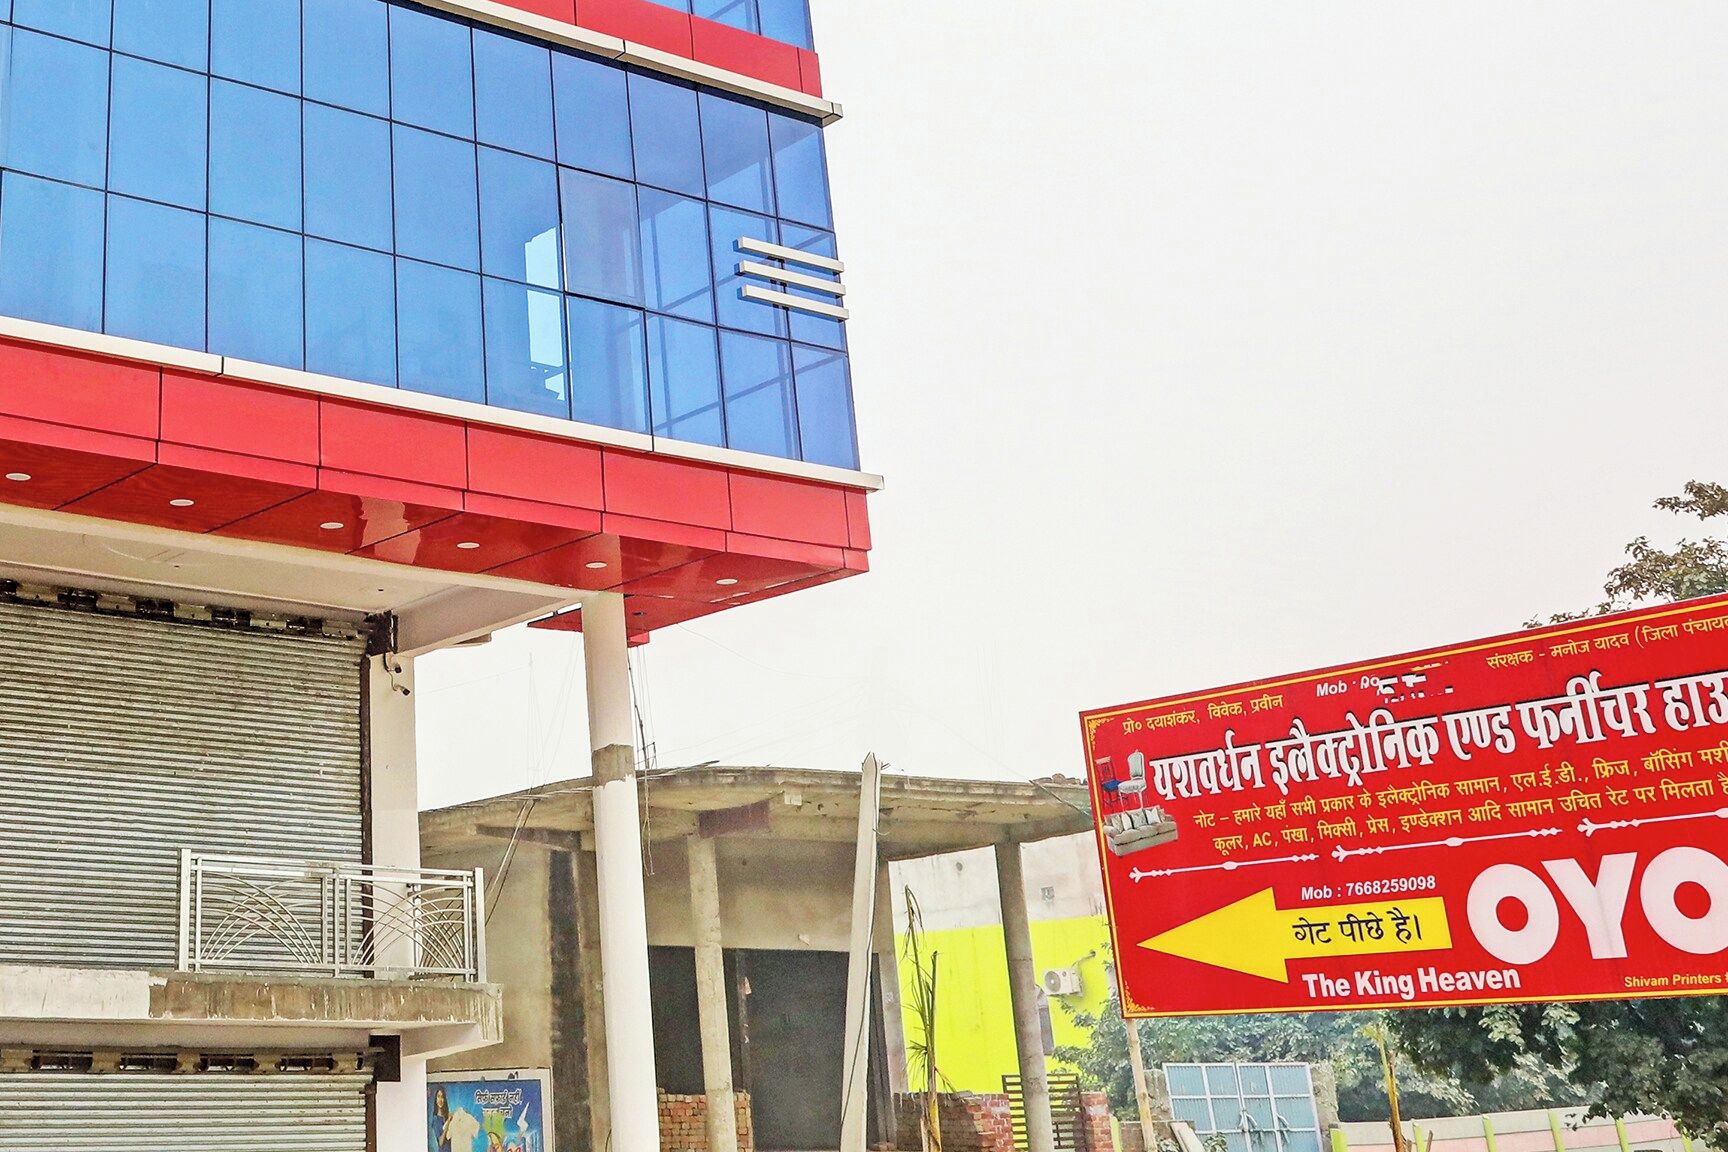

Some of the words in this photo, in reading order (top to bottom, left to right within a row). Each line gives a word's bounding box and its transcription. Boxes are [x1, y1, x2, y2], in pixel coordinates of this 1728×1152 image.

[1487, 649, 1533, 670] संरक्षक
[1549, 639, 1590, 658] मनोज
[1593, 632, 1629, 649] यादव
[1316, 680, 1348, 697] Mob
[1207, 701, 1247, 720] विवेक,
[1250, 694, 1284, 714] प्रवीन
[1150, 729, 1265, 801] यशवर्धन
[1442, 705, 1516, 762] एण्ड
[1515, 670, 1657, 750] फर्नीचर
[1193, 810, 1216, 829] नोट
[1232, 803, 1262, 826] हमारे
[1263, 798, 1288, 820] यहाँ
[1289, 794, 1317, 817] सभी
[1319, 797, 1355, 815] प्रकार
[1359, 788, 1373, 809] के
[1467, 799, 1502, 823] आदि
[1506, 798, 1554, 819] सामान
[1557, 790, 1602, 812] उचित
[1607, 785, 1630, 807] रेट
[1632, 785, 1657, 804] पर
[1659, 777, 1714, 800] मिलता
[1301, 886, 1333, 901] Mob
[1345, 875, 1436, 897] 7668259098
[1466, 846, 1728, 966] OYO
[1292, 917, 1332, 945] गेट
[1338, 911, 1385, 943] पीछे
[1301, 973, 1351, 998] The
[1354, 970, 1414, 1000] King
[1417, 966, 1521, 993] Heaven
[1624, 975, 1669, 988] Shivam
[1672, 973, 1722, 985] Printers
